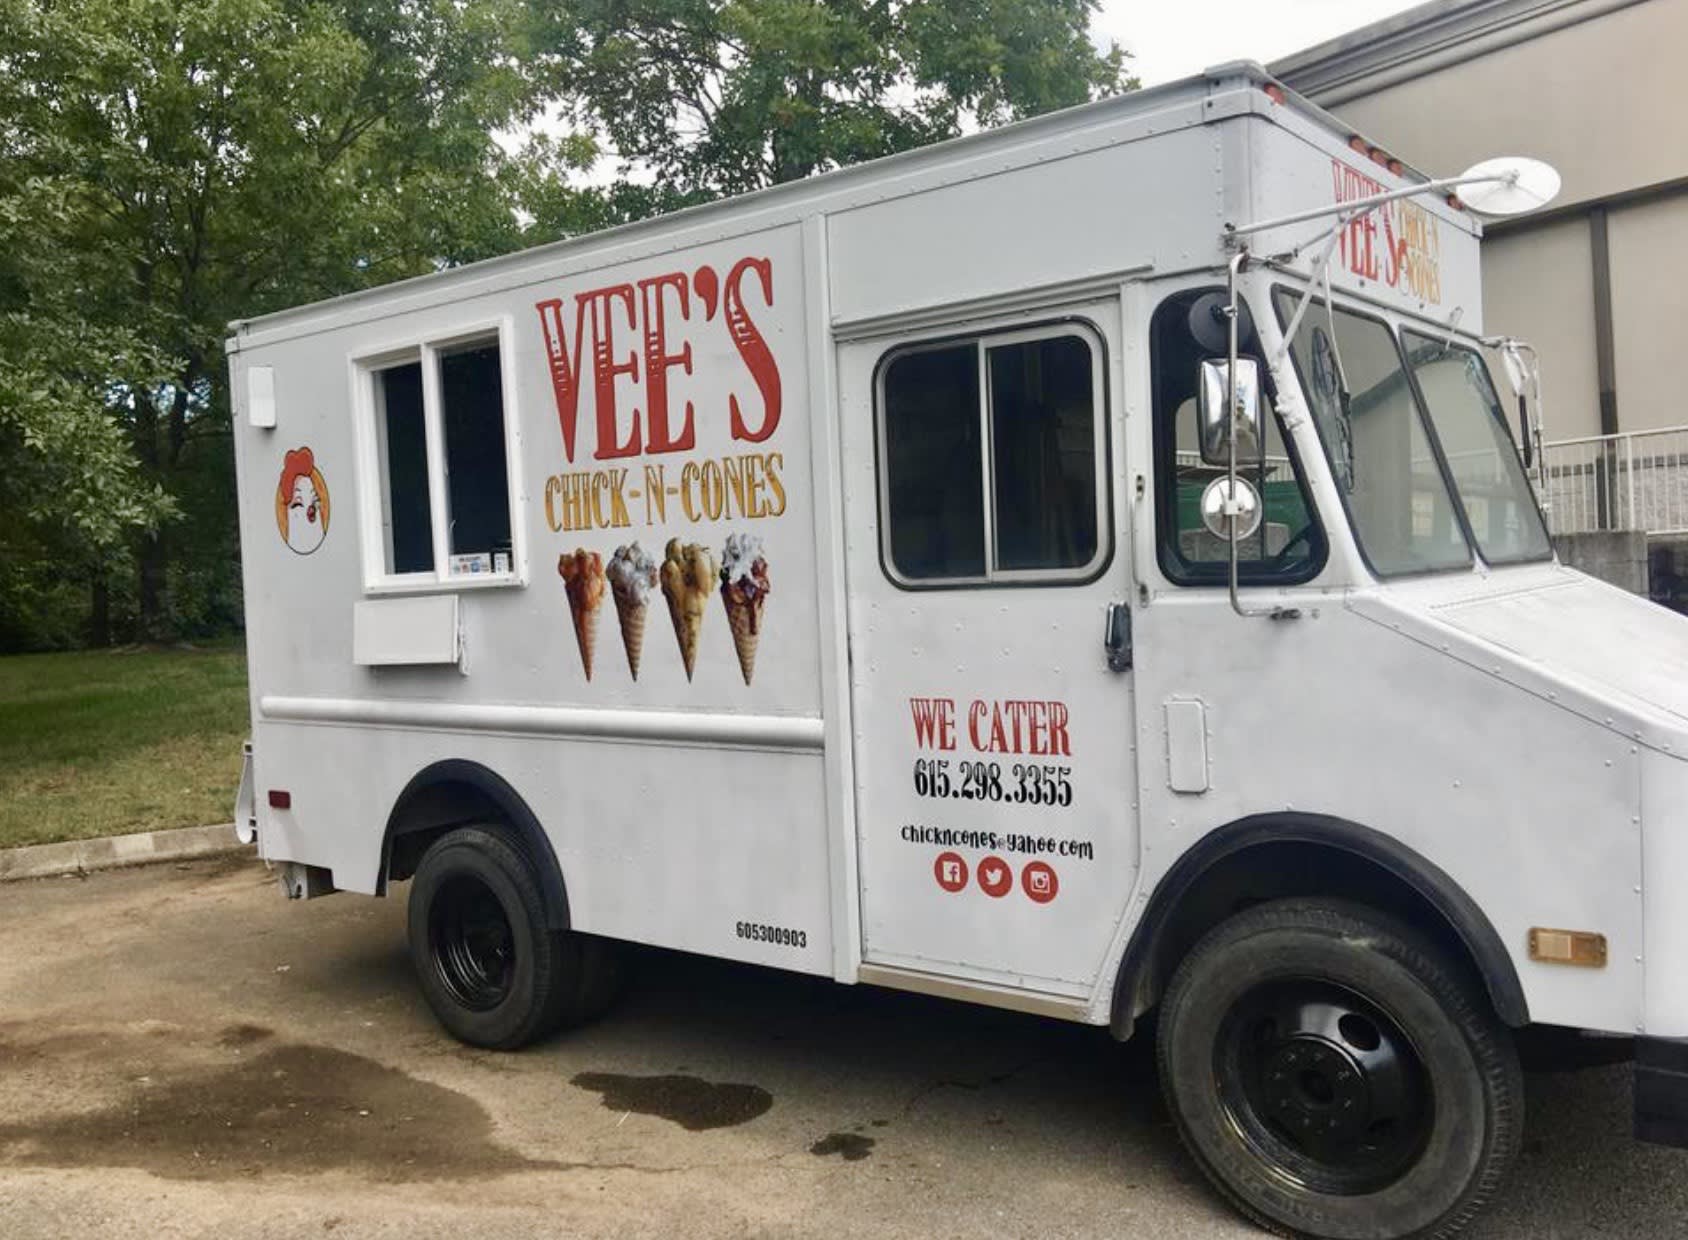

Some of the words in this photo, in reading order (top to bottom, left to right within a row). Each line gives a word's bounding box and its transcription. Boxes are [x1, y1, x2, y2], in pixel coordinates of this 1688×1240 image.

[535, 256, 782, 464] VEE'S
[544, 452, 786, 532] CHICK-N-CONES
[910, 697, 957, 751] WE
[967, 699, 1072, 756] CATER
[913, 758, 1073, 807] 615.298.3355
[736, 920, 807, 948] 605300903
